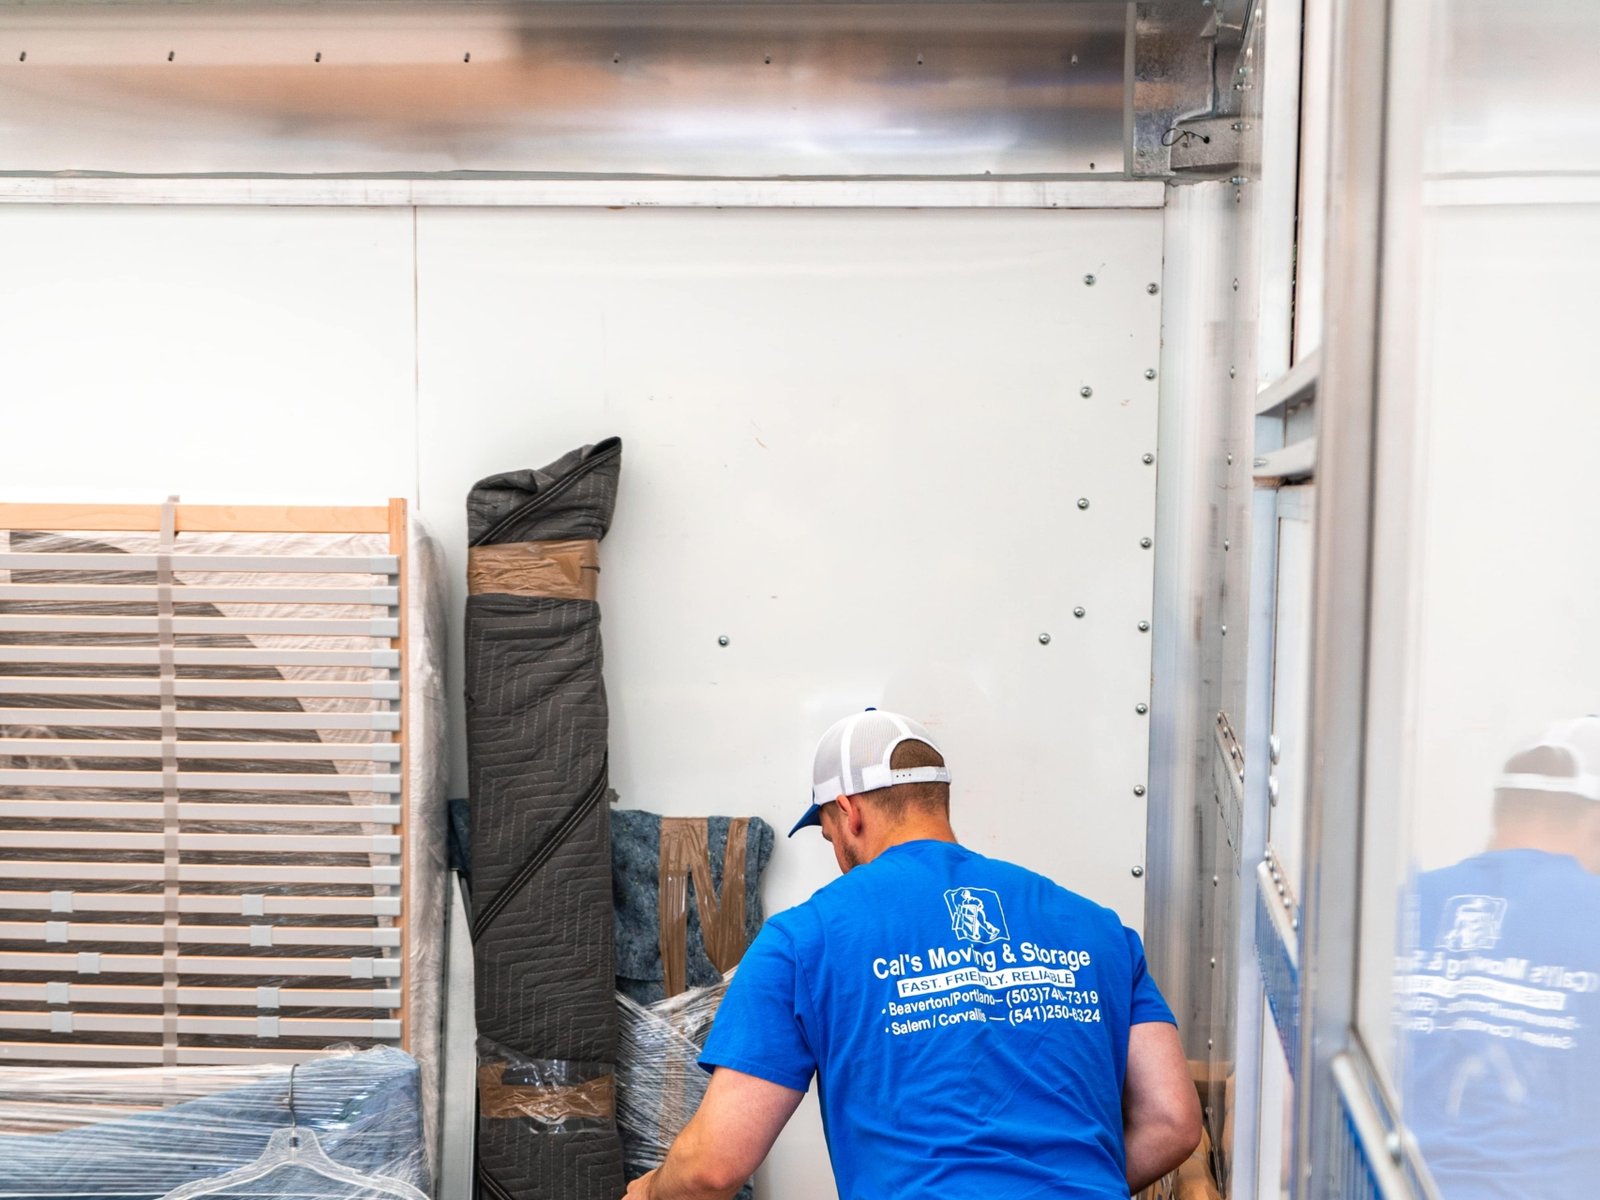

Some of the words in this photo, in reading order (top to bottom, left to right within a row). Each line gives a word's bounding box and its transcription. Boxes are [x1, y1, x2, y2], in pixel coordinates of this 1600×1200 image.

[872, 954, 923, 979] Cal's
[928, 943, 997, 972] Moving
[1002, 943, 1017, 963] &
[1020, 942, 1091, 972] Storage
[901, 979, 942, 994] FAST.
[1012, 970, 1073, 984] RELIABLE
[891, 1018, 931, 1035] Salem
